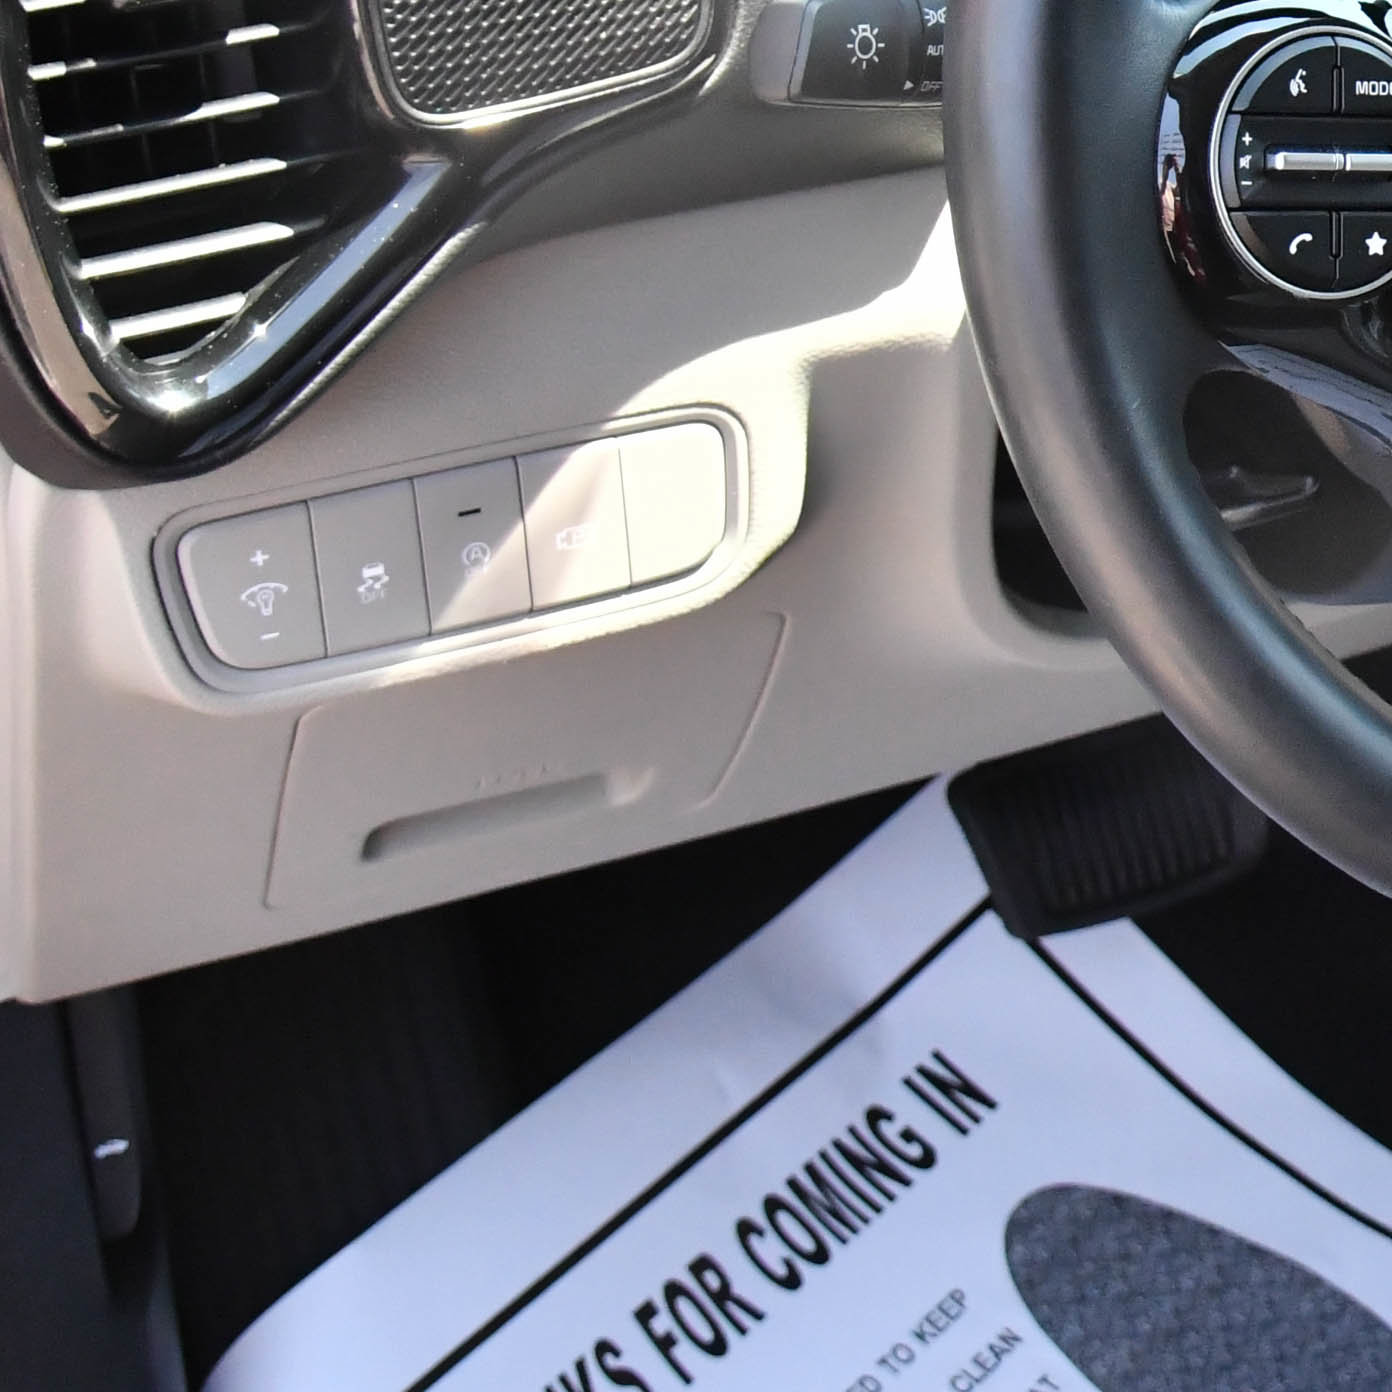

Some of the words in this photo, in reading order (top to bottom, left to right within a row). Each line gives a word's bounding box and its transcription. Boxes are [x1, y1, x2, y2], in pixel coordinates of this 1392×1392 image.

[926, 44, 944, 56] AUT
[633, 1252, 766, 1385] FOR
[735, 1103, 938, 1291] COMING
[902, 1048, 999, 1136] IN
[877, 1342, 916, 1374] TO
[911, 1288, 967, 1344] KEEP
[949, 1326, 1023, 1392] CLEAN
